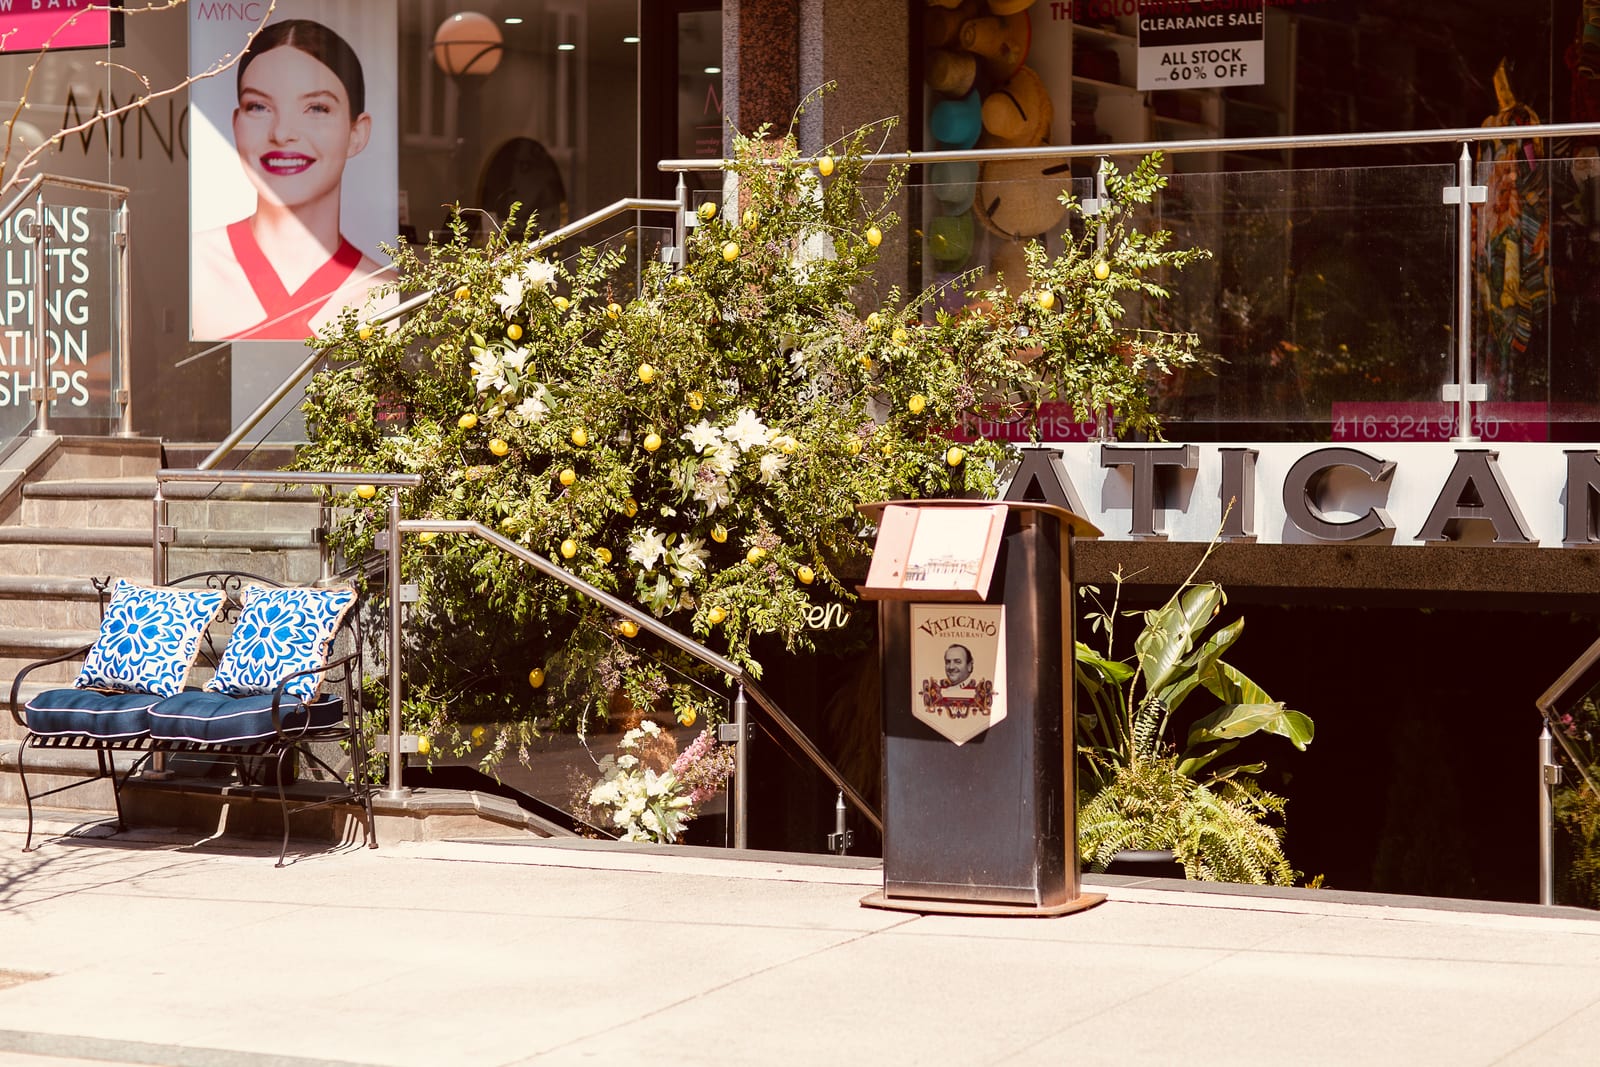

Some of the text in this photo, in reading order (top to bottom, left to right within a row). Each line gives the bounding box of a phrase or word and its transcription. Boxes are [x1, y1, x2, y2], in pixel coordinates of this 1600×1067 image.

[197, 3, 261, 22] MYNC
[1050, 1, 1083, 21] THE
[1140, 12, 1263, 32] CLEARANCE SALE
[1161, 48, 1243, 66] ALL STOCK
[1169, 63, 1248, 81] 60% OFF
[59, 86, 188, 163] MYN
[0, 206, 90, 244] IONS
[6, 247, 90, 285] LITS
[0, 288, 89, 326] PING
[0, 369, 89, 407] SHPS
[917, 615, 997, 637] VATICANO
